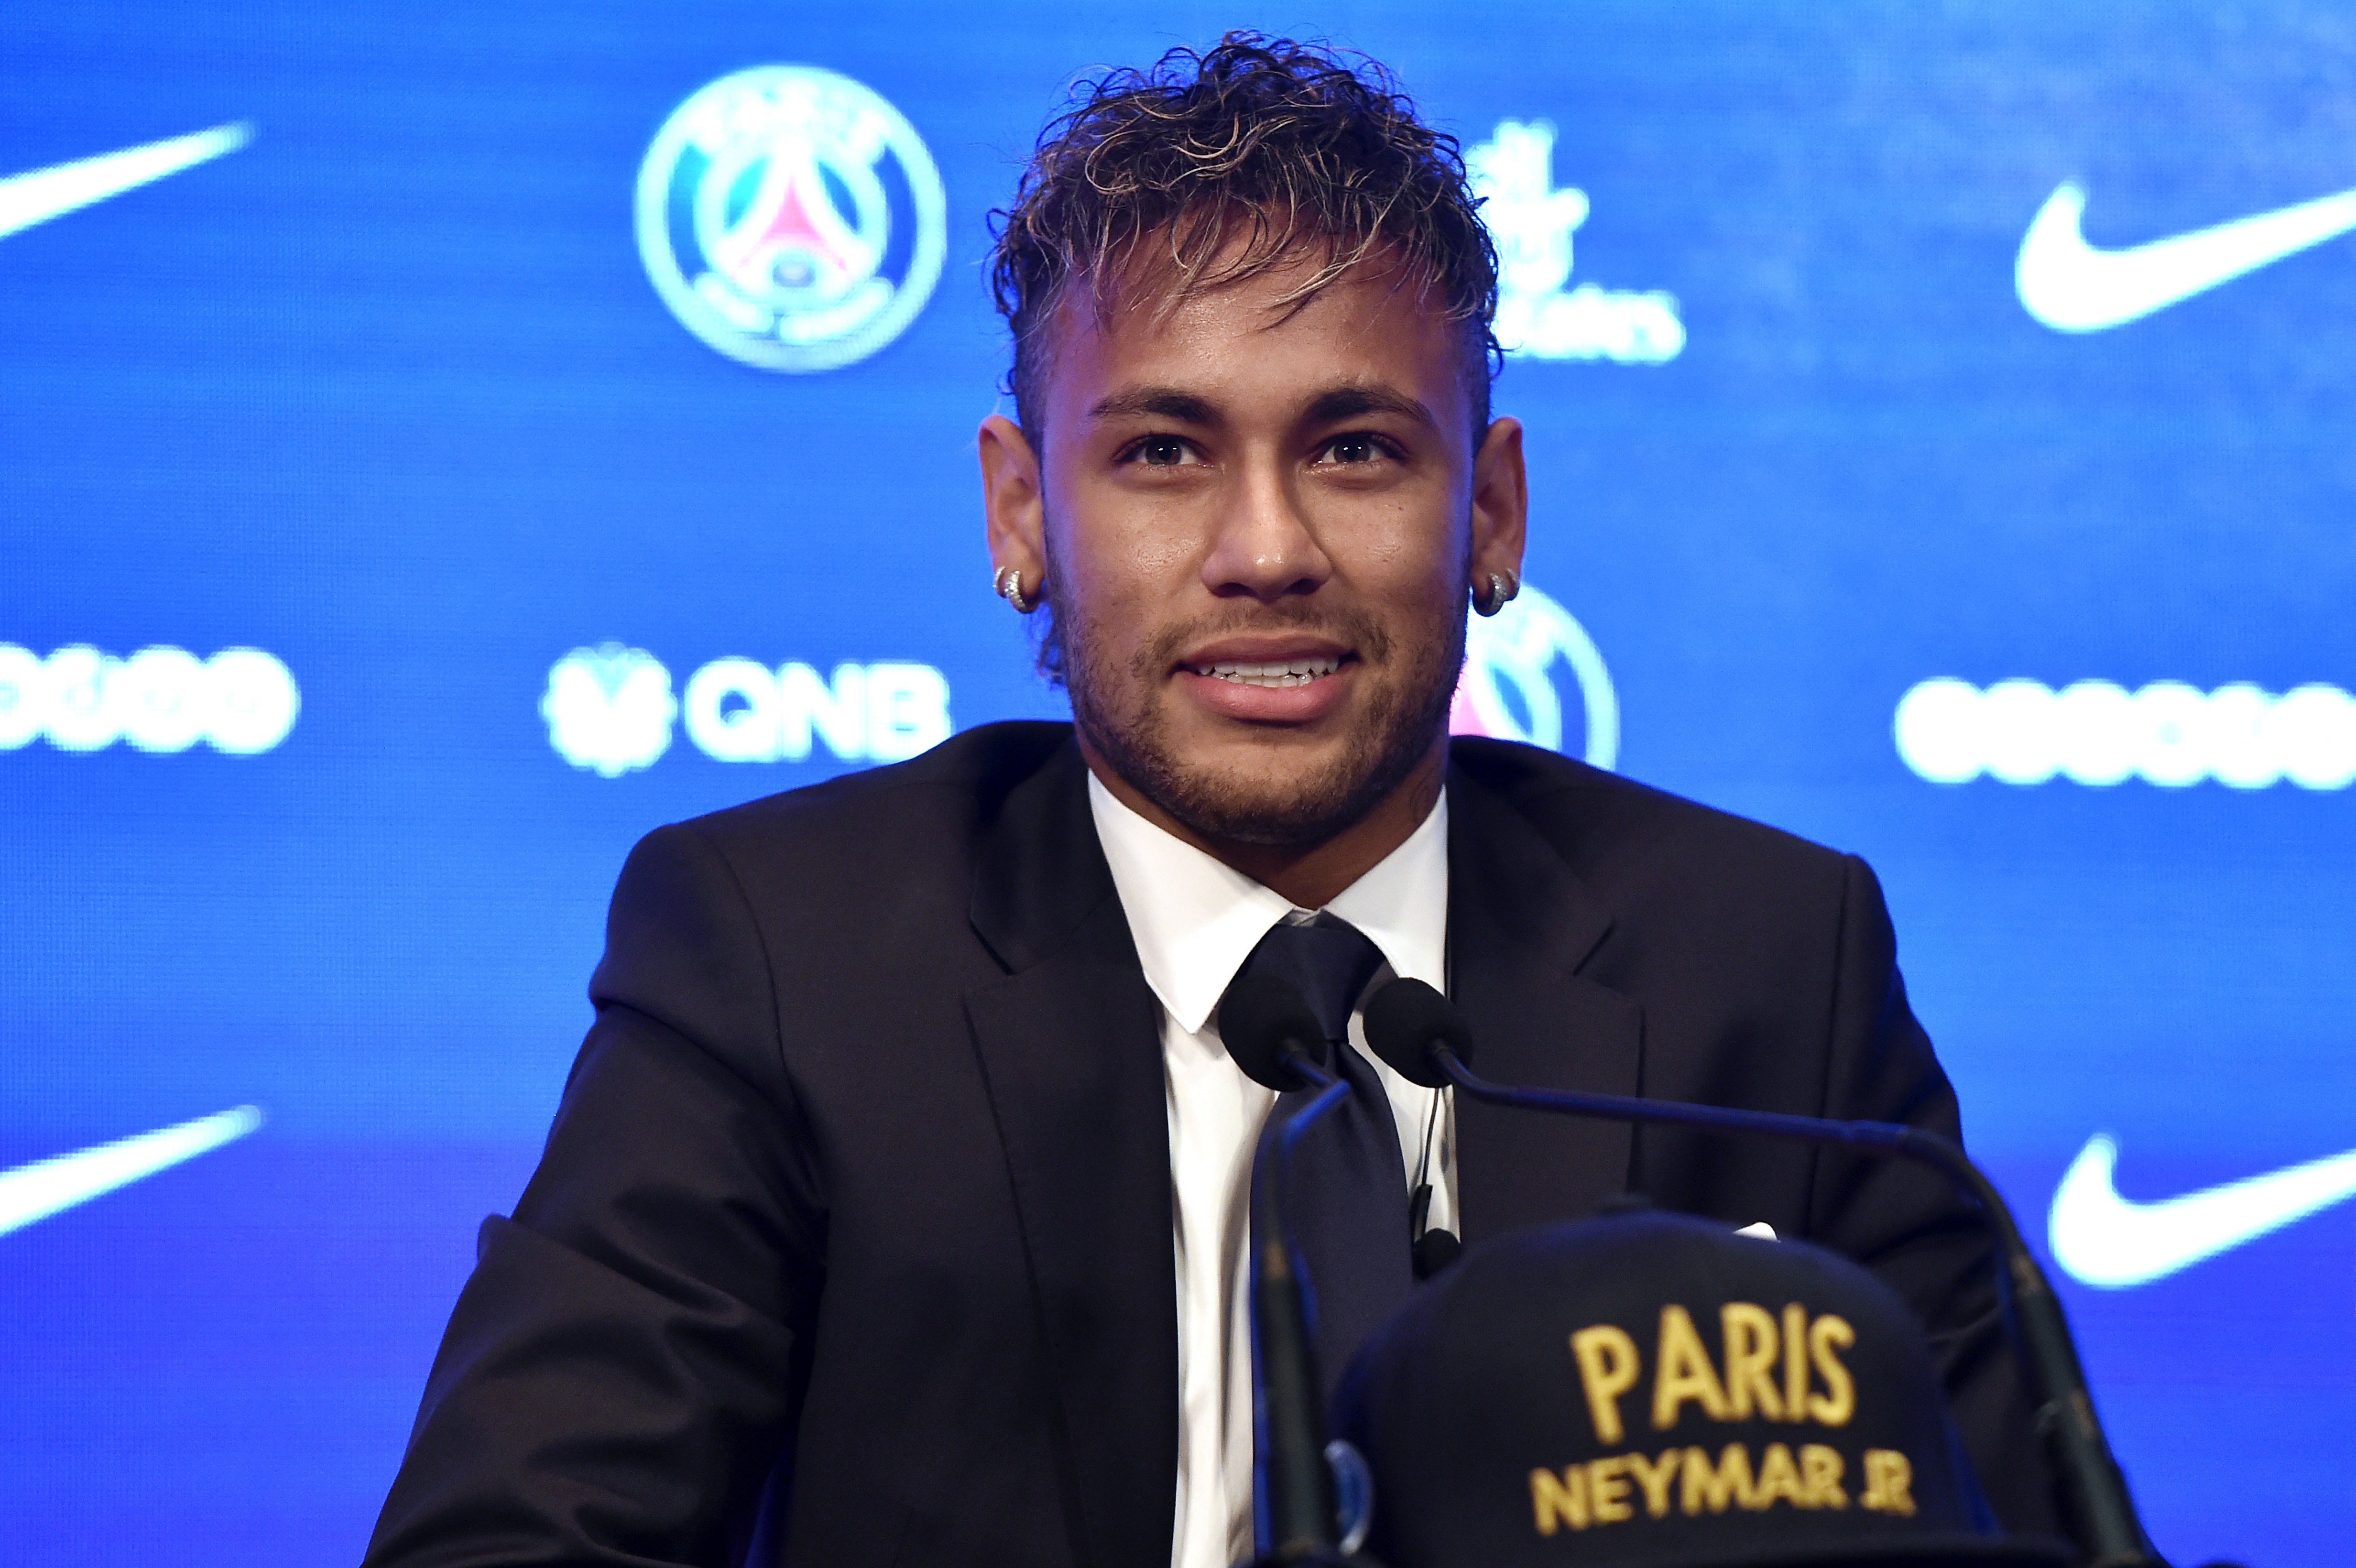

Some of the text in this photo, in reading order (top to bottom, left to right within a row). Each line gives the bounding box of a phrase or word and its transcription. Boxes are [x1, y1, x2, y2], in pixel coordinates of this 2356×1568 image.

[685, 657, 950, 764] QNB
[1570, 1302, 1855, 1444] PARIS
[1531, 1443, 1915, 1535] NEYMAR JR
